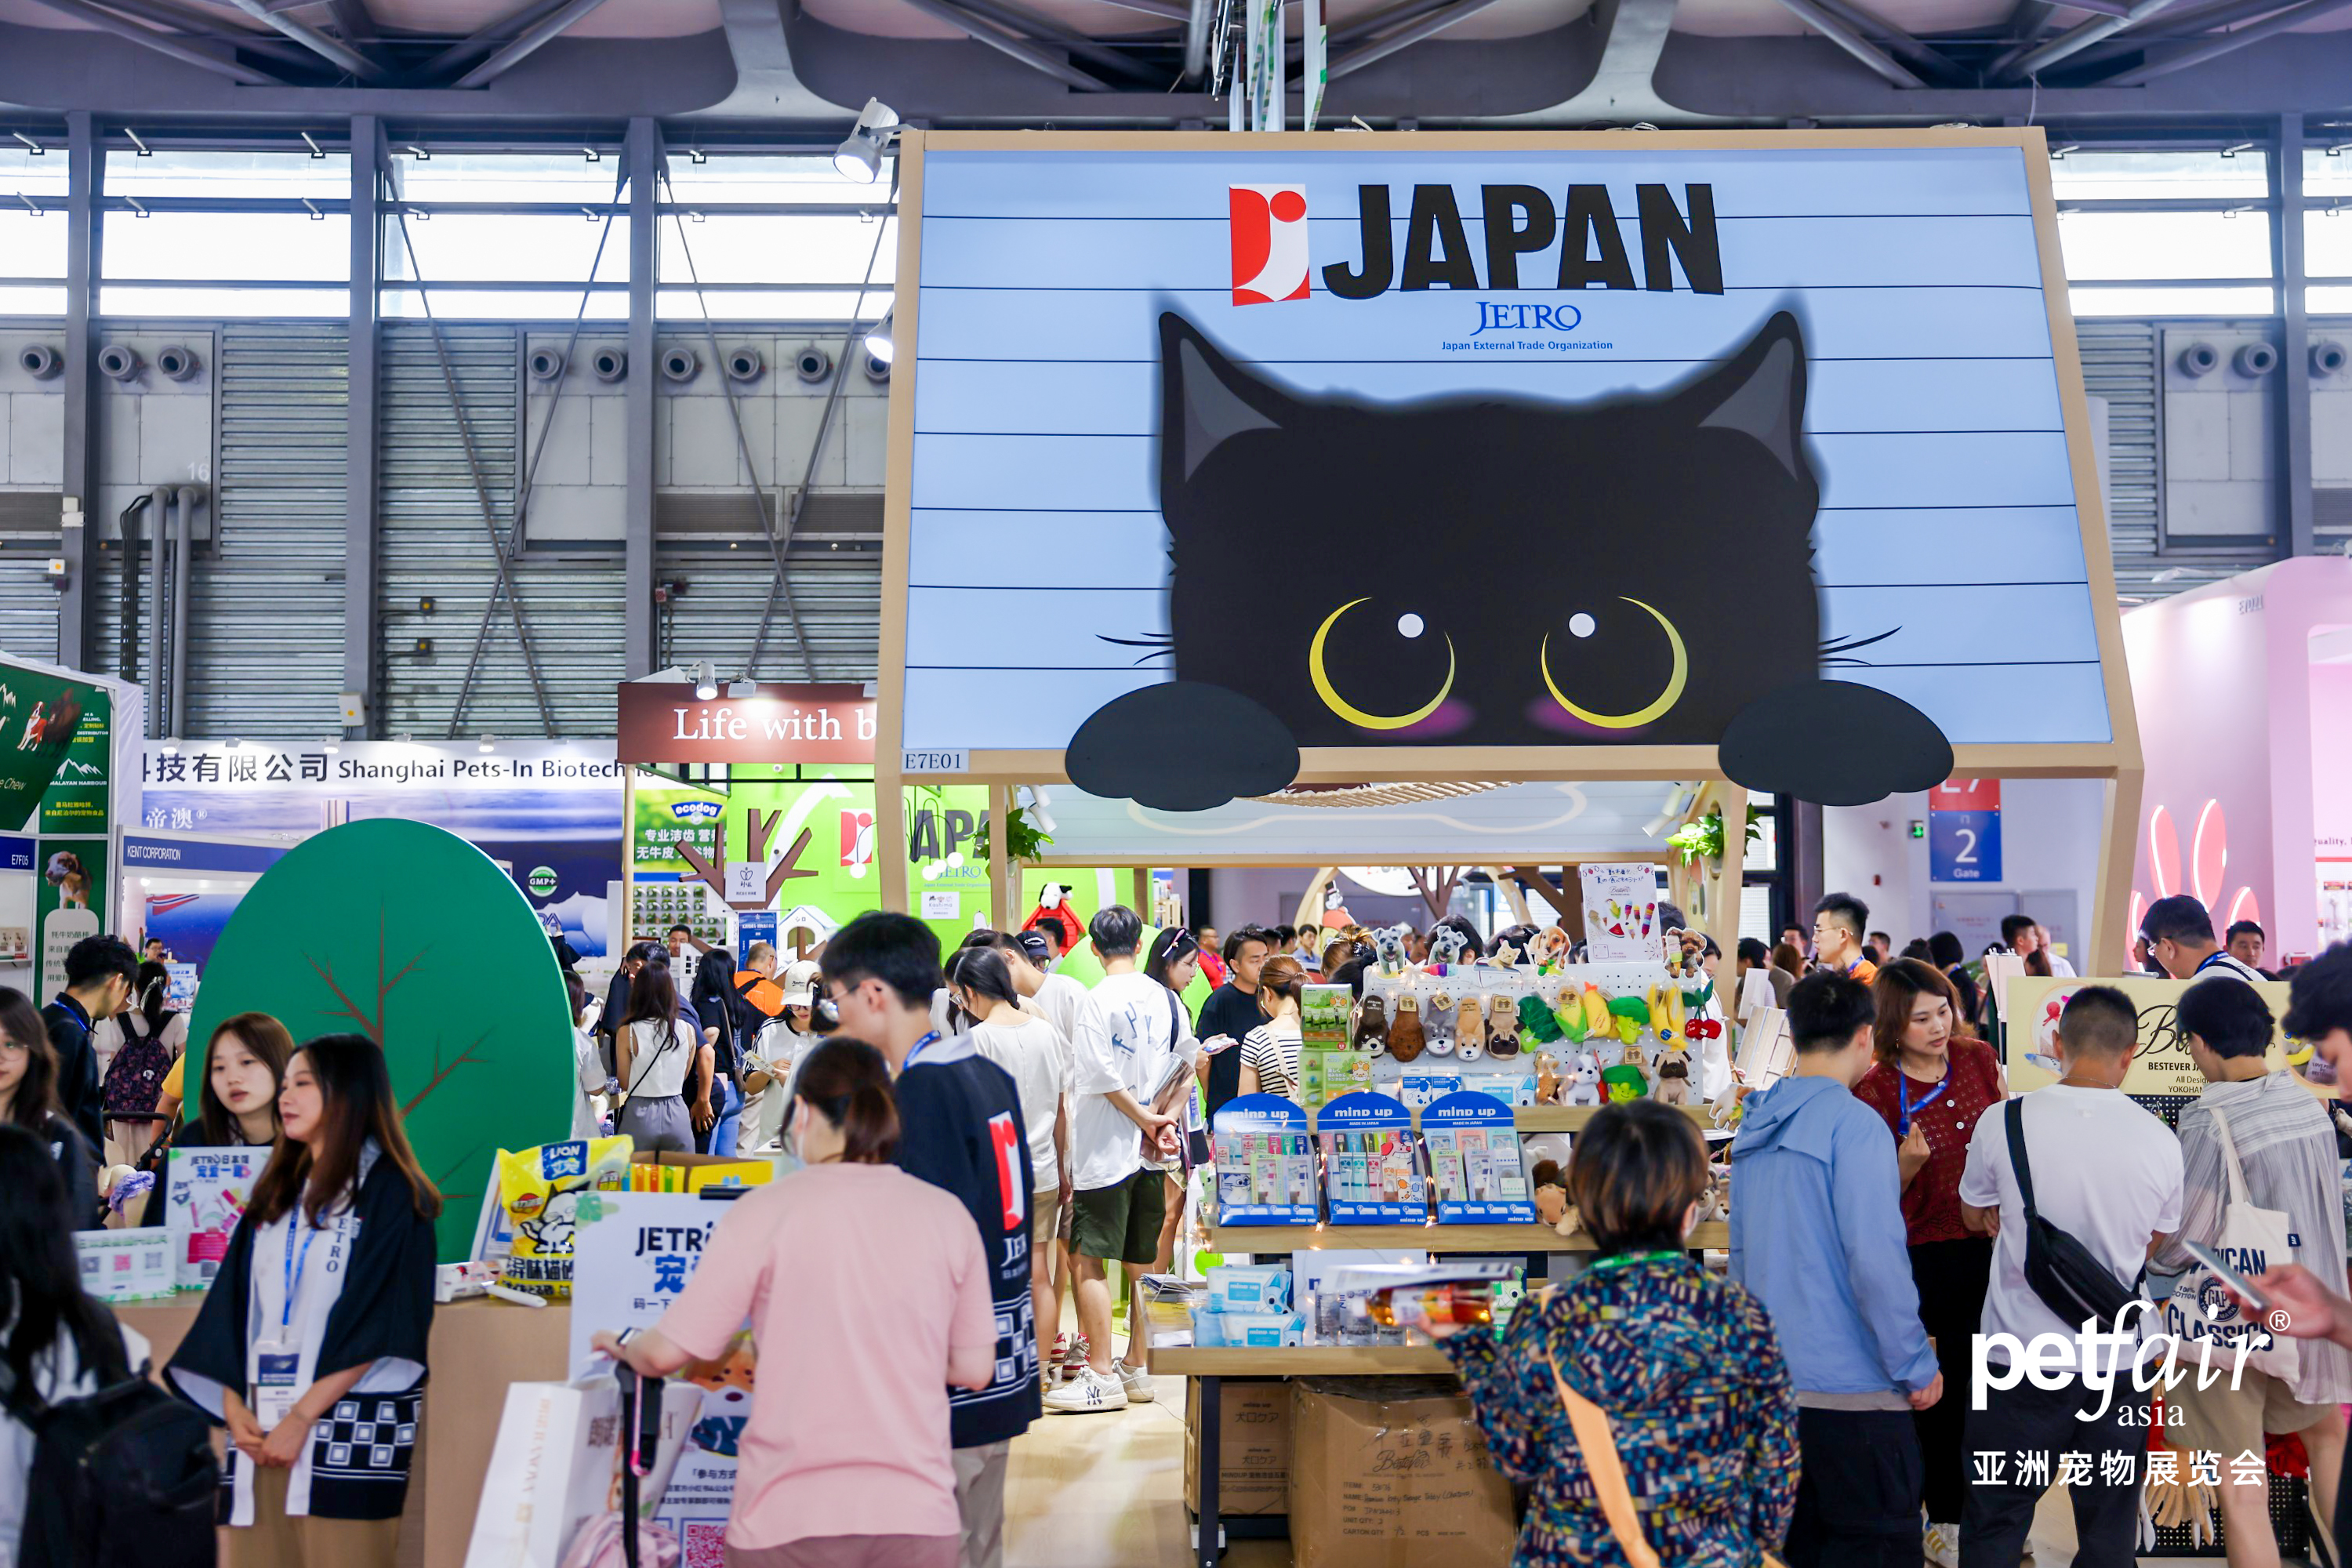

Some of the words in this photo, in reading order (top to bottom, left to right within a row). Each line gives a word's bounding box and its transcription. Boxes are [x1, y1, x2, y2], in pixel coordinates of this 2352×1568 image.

[1321, 183, 1725, 300] JAPAN
[1469, 301, 1582, 336] JETRO
[1442, 341, 1471, 352] Japan
[1474, 341, 1515, 350] External
[1517, 341, 1544, 350] Trade
[1548, 340, 1613, 351] Organization
[187, 462, 210, 482] 16
[673, 707, 747, 740] Life
[761, 708, 843, 741] with
[905, 753, 961, 769] E7E01
[339, 760, 445, 782] Shanghai
[453, 760, 533, 778] Pets-In
[675, 803, 718, 816] ecodog
[645, 829, 695, 843] 专业洁齿
[127, 845, 143, 858] KENT
[143, 846, 181, 861] CORPORATION
[1955, 829, 1978, 863] 2
[1953, 869, 1980, 879] Gate
[529, 877, 556, 886] GMP+
[2148, 1062, 2190, 1071] BESTEVER
[1374, 1109, 1393, 1117] up
[1478, 1108, 1496, 1116] up
[550, 1145, 580, 1159] LION
[326, 1218, 348, 1273] ETRO
[2172, 1290, 2197, 1301] COTTON
[2208, 1290, 2227, 1308] GAP
[1235, 1412, 1279, 1423] 犬口ケア
